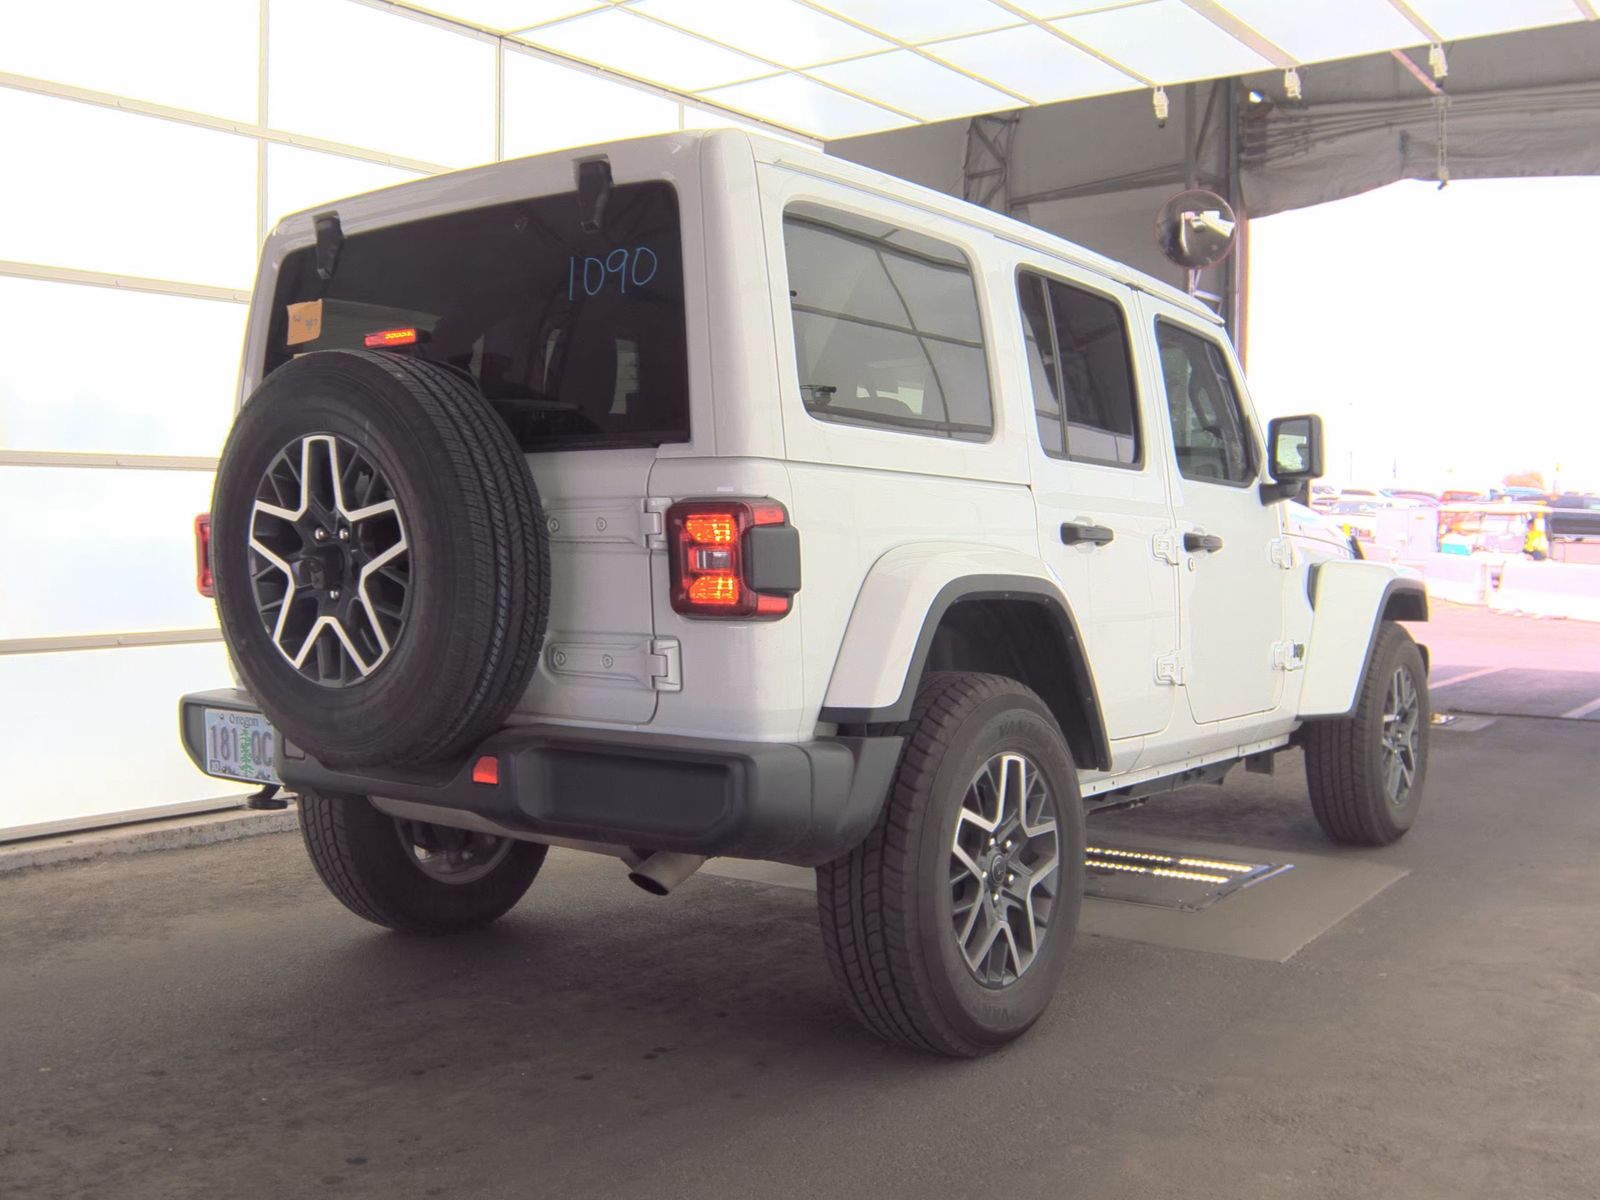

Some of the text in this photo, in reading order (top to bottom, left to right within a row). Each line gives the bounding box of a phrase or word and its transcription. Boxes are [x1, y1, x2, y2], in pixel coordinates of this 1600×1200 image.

[568, 246, 658, 301] 1090
[229, 713, 259, 728] Oregon
[211, 726, 238, 762] 181
